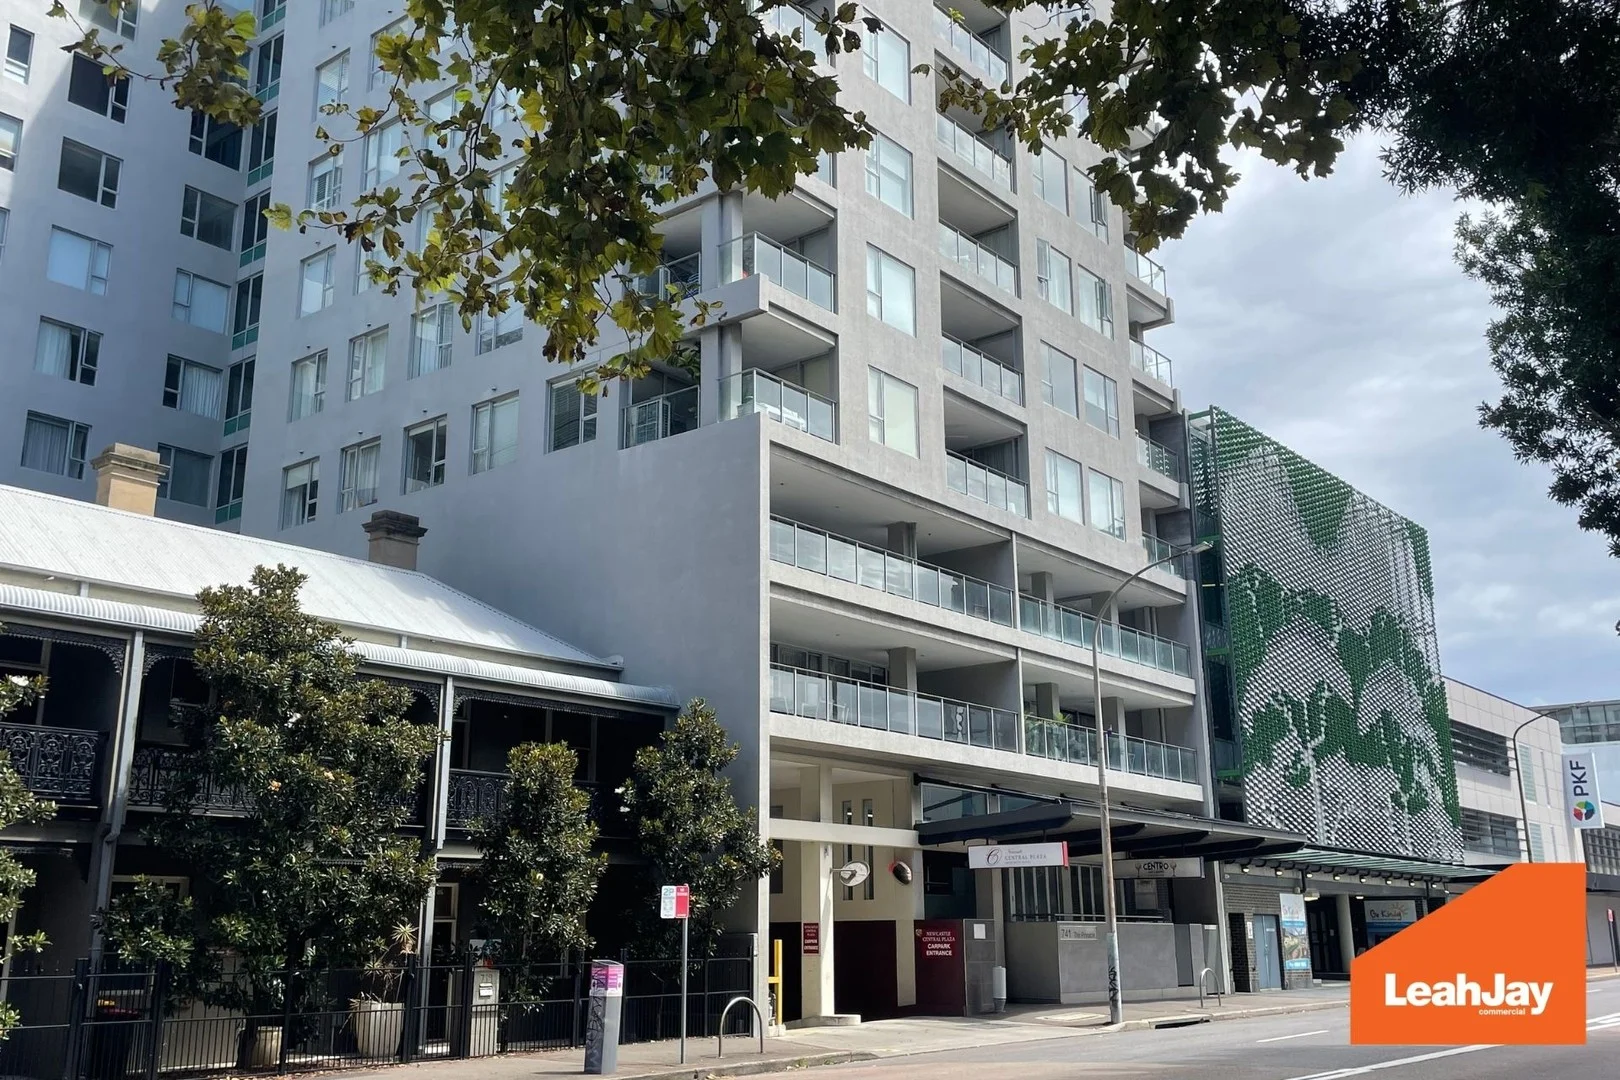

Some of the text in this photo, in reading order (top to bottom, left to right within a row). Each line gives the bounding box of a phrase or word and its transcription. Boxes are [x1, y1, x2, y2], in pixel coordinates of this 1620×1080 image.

[1569, 760, 1589, 796] PKF
[1143, 861, 1169, 870] CENTRO
[663, 887, 675, 896] 2P
[1060, 928, 1071, 938] 741
